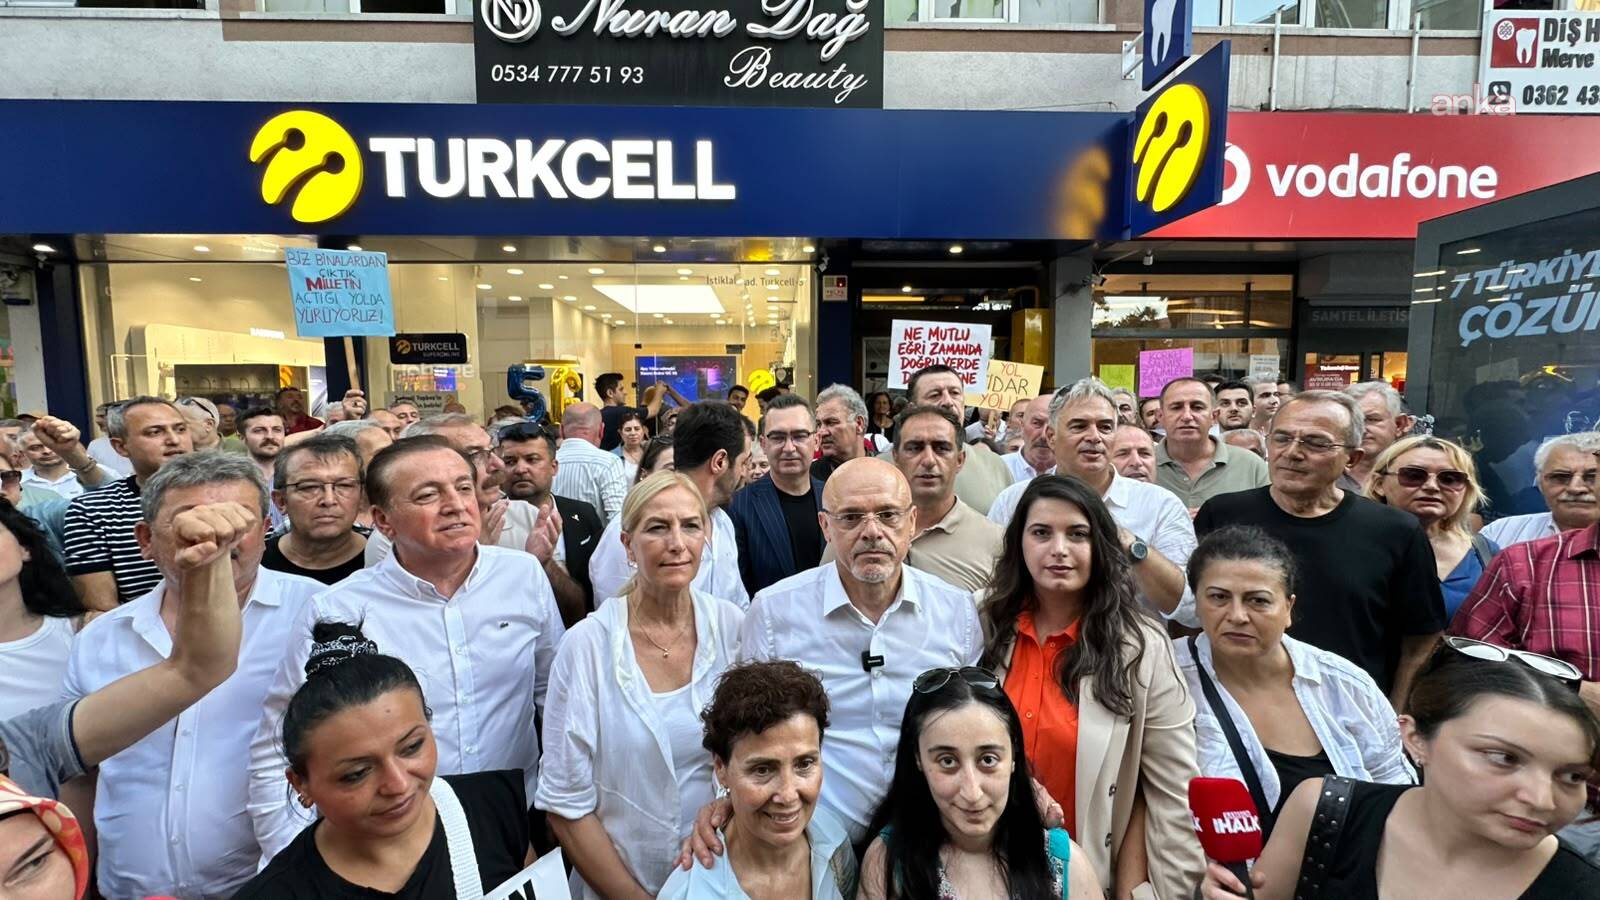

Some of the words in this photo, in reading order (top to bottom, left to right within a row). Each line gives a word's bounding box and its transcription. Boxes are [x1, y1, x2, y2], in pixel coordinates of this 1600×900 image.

[1541, 48, 1594, 68] Merve
[491, 64, 540, 82] 0534
[547, 65, 584, 83] 777
[589, 66, 612, 83] 51
[620, 66, 644, 84] 93
[724, 46, 868, 104] Beauty
[1522, 84, 1569, 105] 0362
[1576, 85, 1600, 105] 43
[369, 137, 736, 200] TURKCELL
[1266, 152, 1498, 199] vodafone
[319, 268, 356, 279] ÇIKTIK
[349, 292, 385, 306] YOLDA
[903, 327, 924, 341] NE
[928, 326, 970, 342] MUTLU
[412, 342, 460, 351] TURKCELL
[929, 342, 983, 356] ZAMANDA
[1001, 362, 1022, 378] YOL
